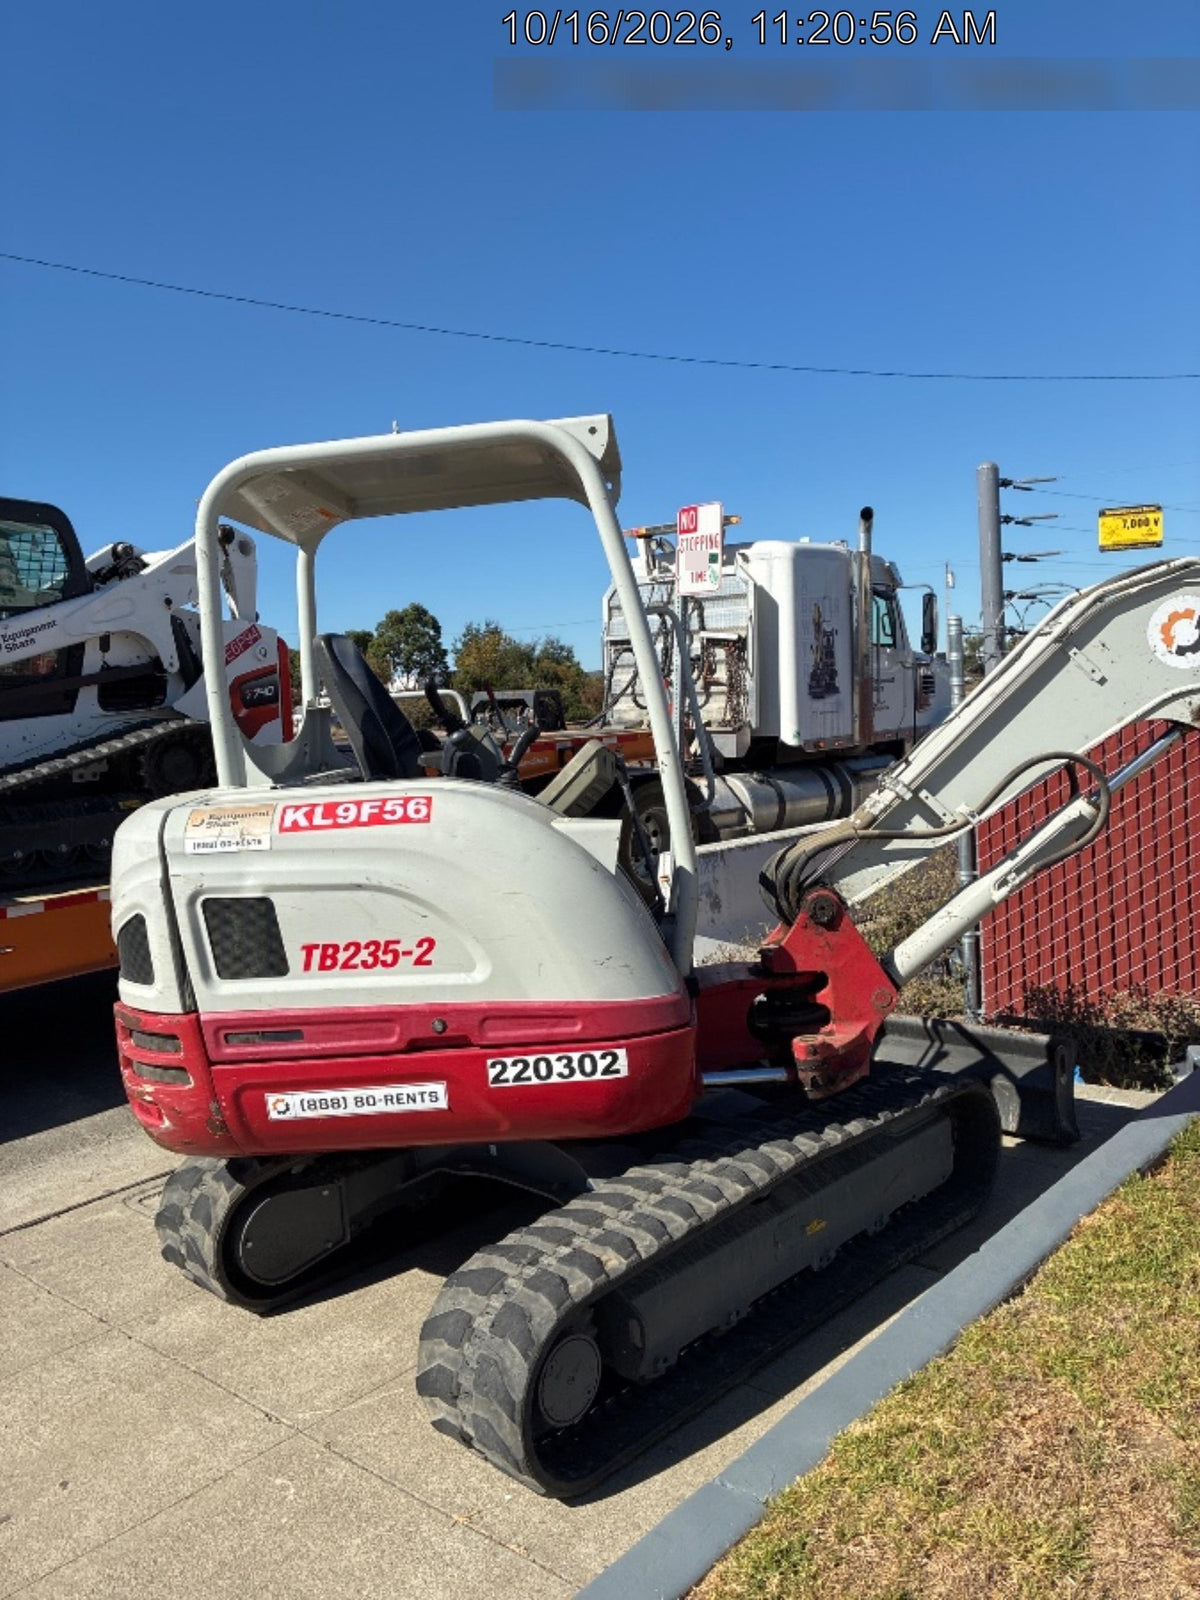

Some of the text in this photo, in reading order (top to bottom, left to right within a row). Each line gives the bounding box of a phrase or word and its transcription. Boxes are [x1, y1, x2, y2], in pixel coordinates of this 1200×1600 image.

[681, 511, 696, 530] NO
[1122, 517, 1160, 530] 7,000 V
[680, 533, 720, 553] STOPPING
[690, 571, 707, 583] TIME
[283, 797, 429, 828] KL9F56
[301, 937, 436, 972] TB235-2
[490, 1051, 622, 1085] 220302
[300, 1091, 439, 1112] (888) 80-RENTS
